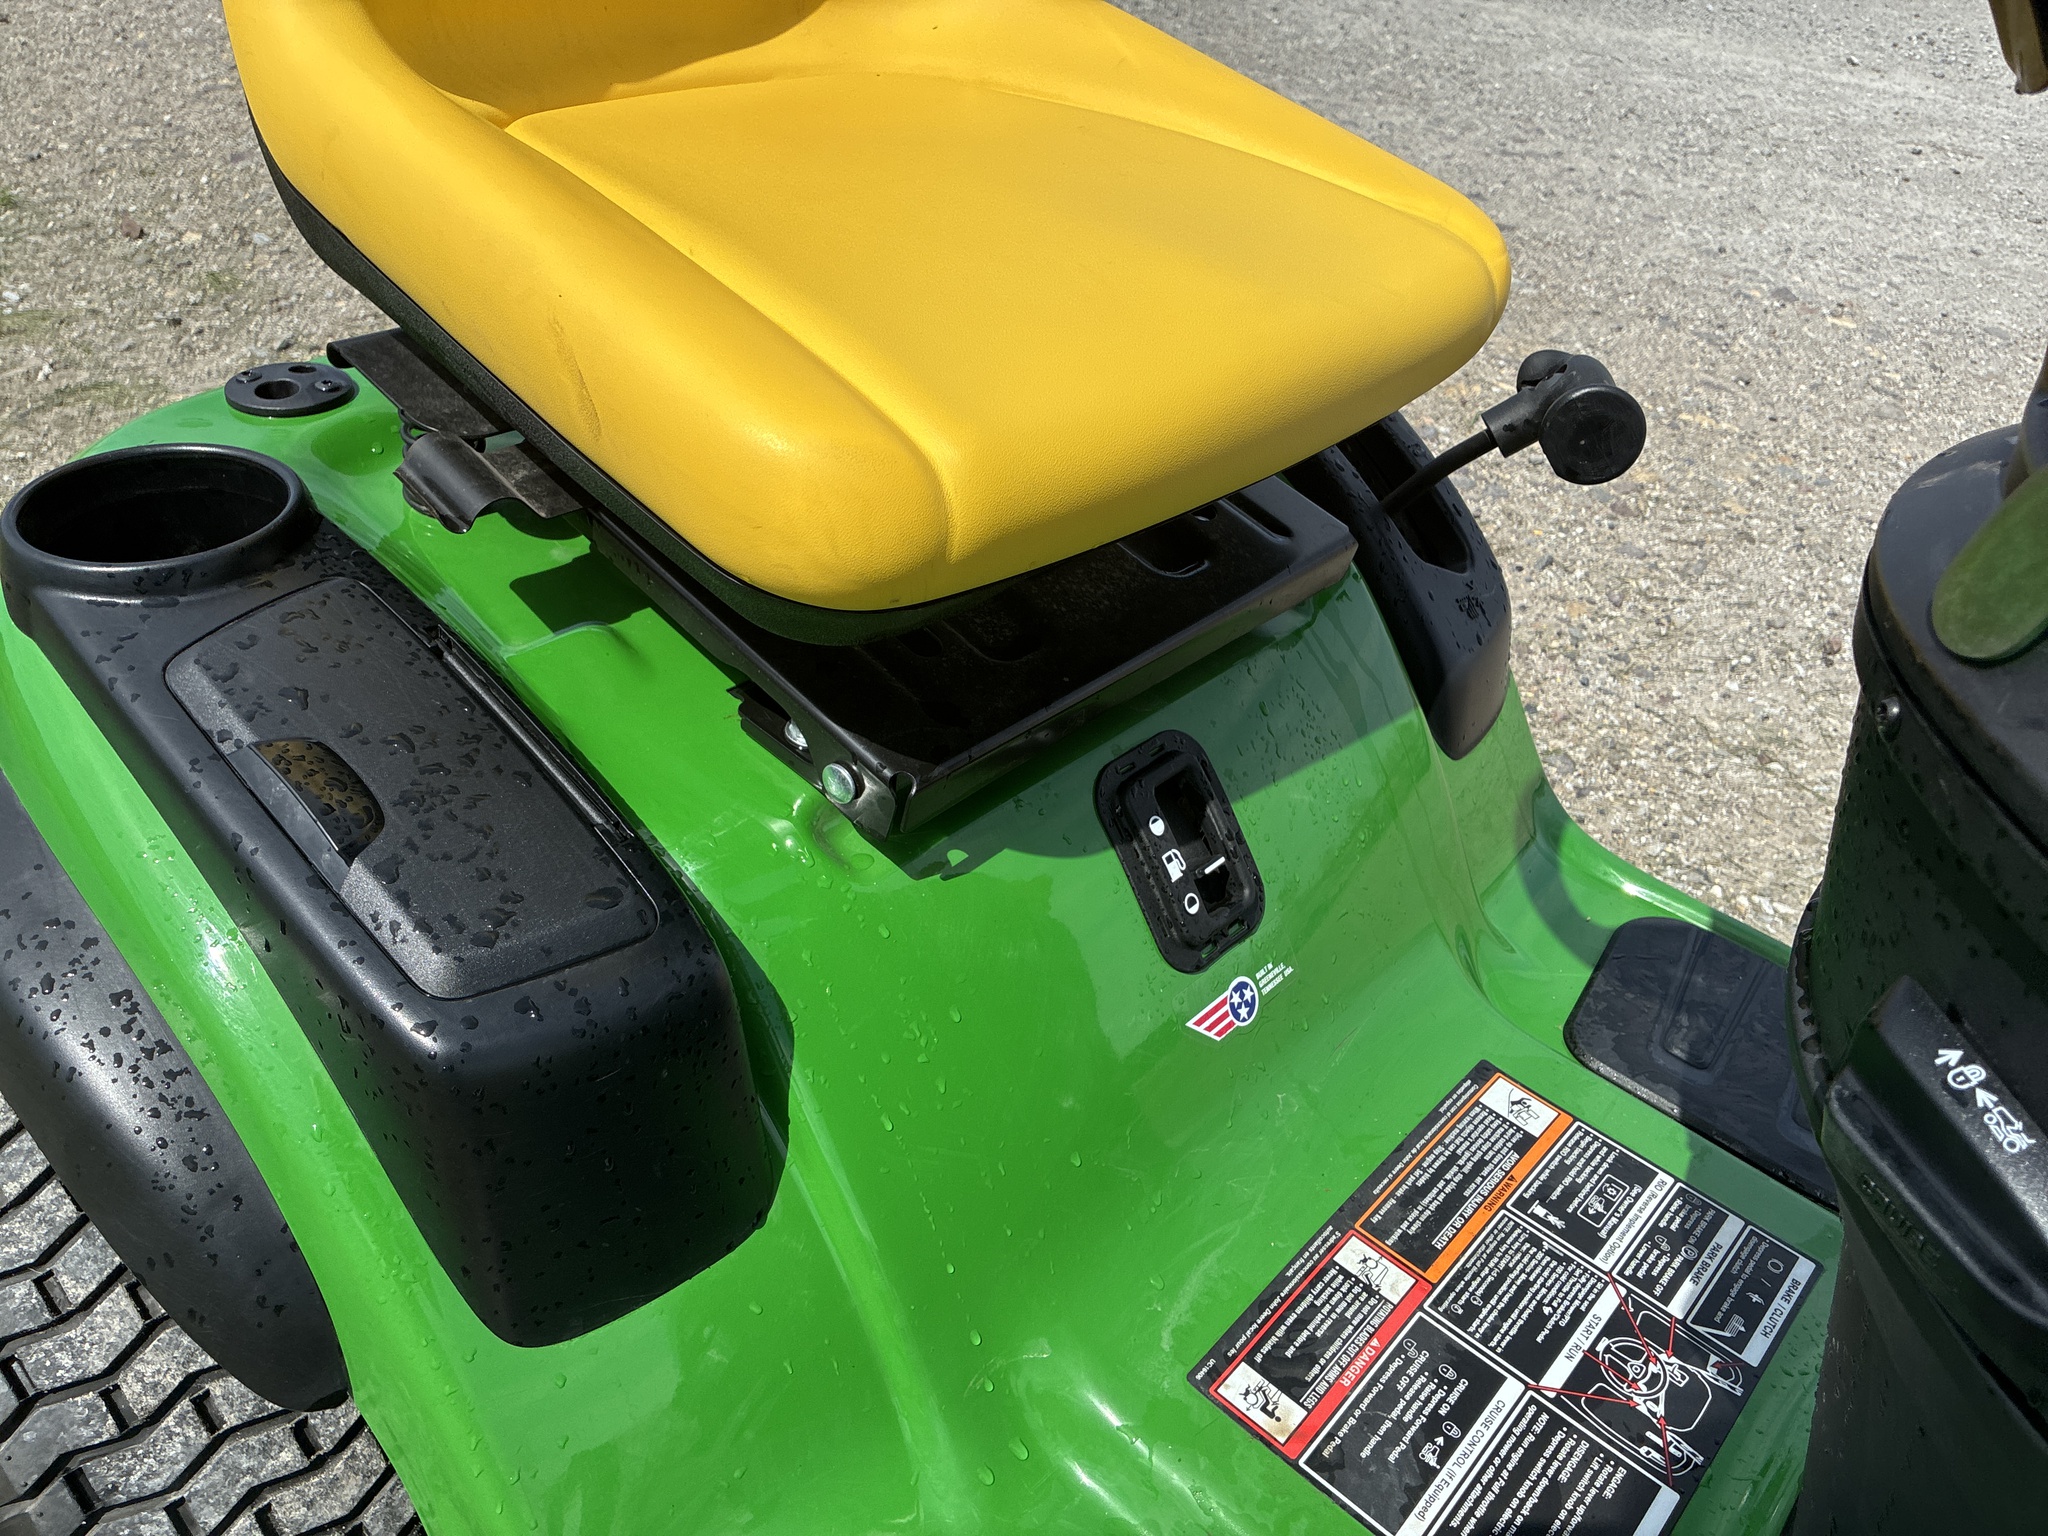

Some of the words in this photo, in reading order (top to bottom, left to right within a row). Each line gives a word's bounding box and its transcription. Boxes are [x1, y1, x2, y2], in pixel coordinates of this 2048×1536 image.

[1499, 1151, 1521, 1172] AVOID
[1478, 1168, 1507, 1197] SERIOUS
[1628, 1183, 1644, 1199] (See
[1653, 1178, 1668, 1192] RIO
[1460, 1193, 1485, 1220] INJURY
[1482, 1180, 1514, 1213] WARNING
[1613, 1195, 1635, 1219] Owner's
[1635, 1189, 1659, 1215] (Reverse
[1668, 1198, 1683, 1214] Raise
[1451, 1215, 1466, 1229] OR
[1657, 1210, 1674, 1229] handle
[1678, 1203, 1693, 1219] brake
[1683, 1209, 1702, 1231] Depress
[1702, 1207, 1717, 1223] PARK
[1596, 1215, 1620, 1240] Manual)
[1614, 1212, 1642, 1244] Implement
[1668, 1215, 1683, 1233] pedal
[1692, 1219, 1709, 1238] BRAKE
[1433, 1225, 1458, 1251] DEATH
[1687, 1234, 1698, 1245] ON
[1598, 1240, 1622, 1265] Option)
[1634, 1242, 1652, 1261] Lower
[1645, 1248, 1662, 1265] brake
[1669, 1253, 1685, 1270] PARK
[1704, 1241, 1724, 1263] PARK
[1622, 1257, 1641, 1278] handle
[1635, 1261, 1651, 1280] pedal
[1650, 1254, 1671, 1278] Depress
[1658, 1266, 1676, 1287] BRAKE
[1688, 1259, 1712, 1287] BRAKE
[1651, 1283, 1665, 1297] OFF
[1780, 1277, 1802, 1305] BRAKE
[1368, 1301, 1395, 1329] ROTATING
[1579, 1313, 1603, 1341] START
[1760, 1306, 1785, 1340] CLUTCH
[1353, 1323, 1376, 1348] BLADES
[1336, 1353, 1352, 1369] OFF
[1344, 1342, 1360, 1359] CUT
[1564, 1341, 1583, 1363] RUN
[1323, 1362, 1343, 1385] ARMS
[1339, 1345, 1377, 1388] DANGER
[1378, 1356, 1404, 1385] Depress
[1405, 1349, 1430, 1378] CRUISE
[1314, 1378, 1330, 1396] AND
[1395, 1374, 1411, 1393] OFF
[1403, 1374, 1428, 1402] Release
[1418, 1381, 1437, 1402] Raise
[1445, 1377, 1470, 1406] CRUISE
[1302, 1390, 1321, 1410] LEGS
[1358, 1381, 1385, 1412] Forward
[1421, 1387, 1447, 1418] Depress
[1352, 1408, 1362, 1419] or
[1386, 1397, 1408, 1422] pedal,
[1401, 1398, 1424, 1424] handle
[1437, 1402, 1452, 1417] ON
[1480, 1399, 1506, 1432] CRUISE
[1511, 1402, 1539, 1438] operating
[1336, 1416, 1358, 1439] Brake
[1376, 1418, 1394, 1437] then
[1401, 1414, 1428, 1445] Forward
[1530, 1411, 1550, 1436] NOTE:
[1321, 1435, 1342, 1459] Pedal
[1358, 1433, 1382, 1460] handle
[1451, 1428, 1486, 1470] CONTROL
[1497, 1433, 1517, 1460] mower
[1520, 1431, 1536, 1450] Run
[1541, 1429, 1566, 1460] Depress
[1555, 1436, 1577, 1462] Rotate
[1386, 1441, 1408, 1465] Pedal
[1492, 1455, 1502, 1468] or
[1505, 1445, 1526, 1473] engine
[1556, 1439, 1590, 1485] DISENGAGE:
[1589, 1456, 1604, 1472] Lift
[1444, 1467, 1457, 1482] (If
[1479, 1464, 1497, 1487] other
[1500, 1468, 1510, 1481] at
[1527, 1456, 1548, 1482] switch
[1544, 1458, 1562, 1480] lever
[1575, 1467, 1595, 1494] switch
[1593, 1463, 1614, 1490] Rotate
[1490, 1476, 1506, 1495] Full
[1515, 1478, 1534, 1500] knob
[1601, 1465, 1628, 1501] ENGAGE:
[1413, 1477, 1451, 1523] Equipped)
[1448, 1482, 1484, 1530] attachments.
[1473, 1490, 1496, 1520] throttle
[1508, 1496, 1520, 1510] on
[1519, 1476, 1551, 1518] down/back
[1563, 1490, 1582, 1512] knob
[1582, 1486, 1600, 1507] lever
[1459, 1515, 1479, 1536] when
[1491, 1506, 1514, 1536] electric
[1513, 1513, 1525, 1527] on
[1557, 1508, 1569, 1521] on
[1561, 1503, 1588, 1536] up/forwa
